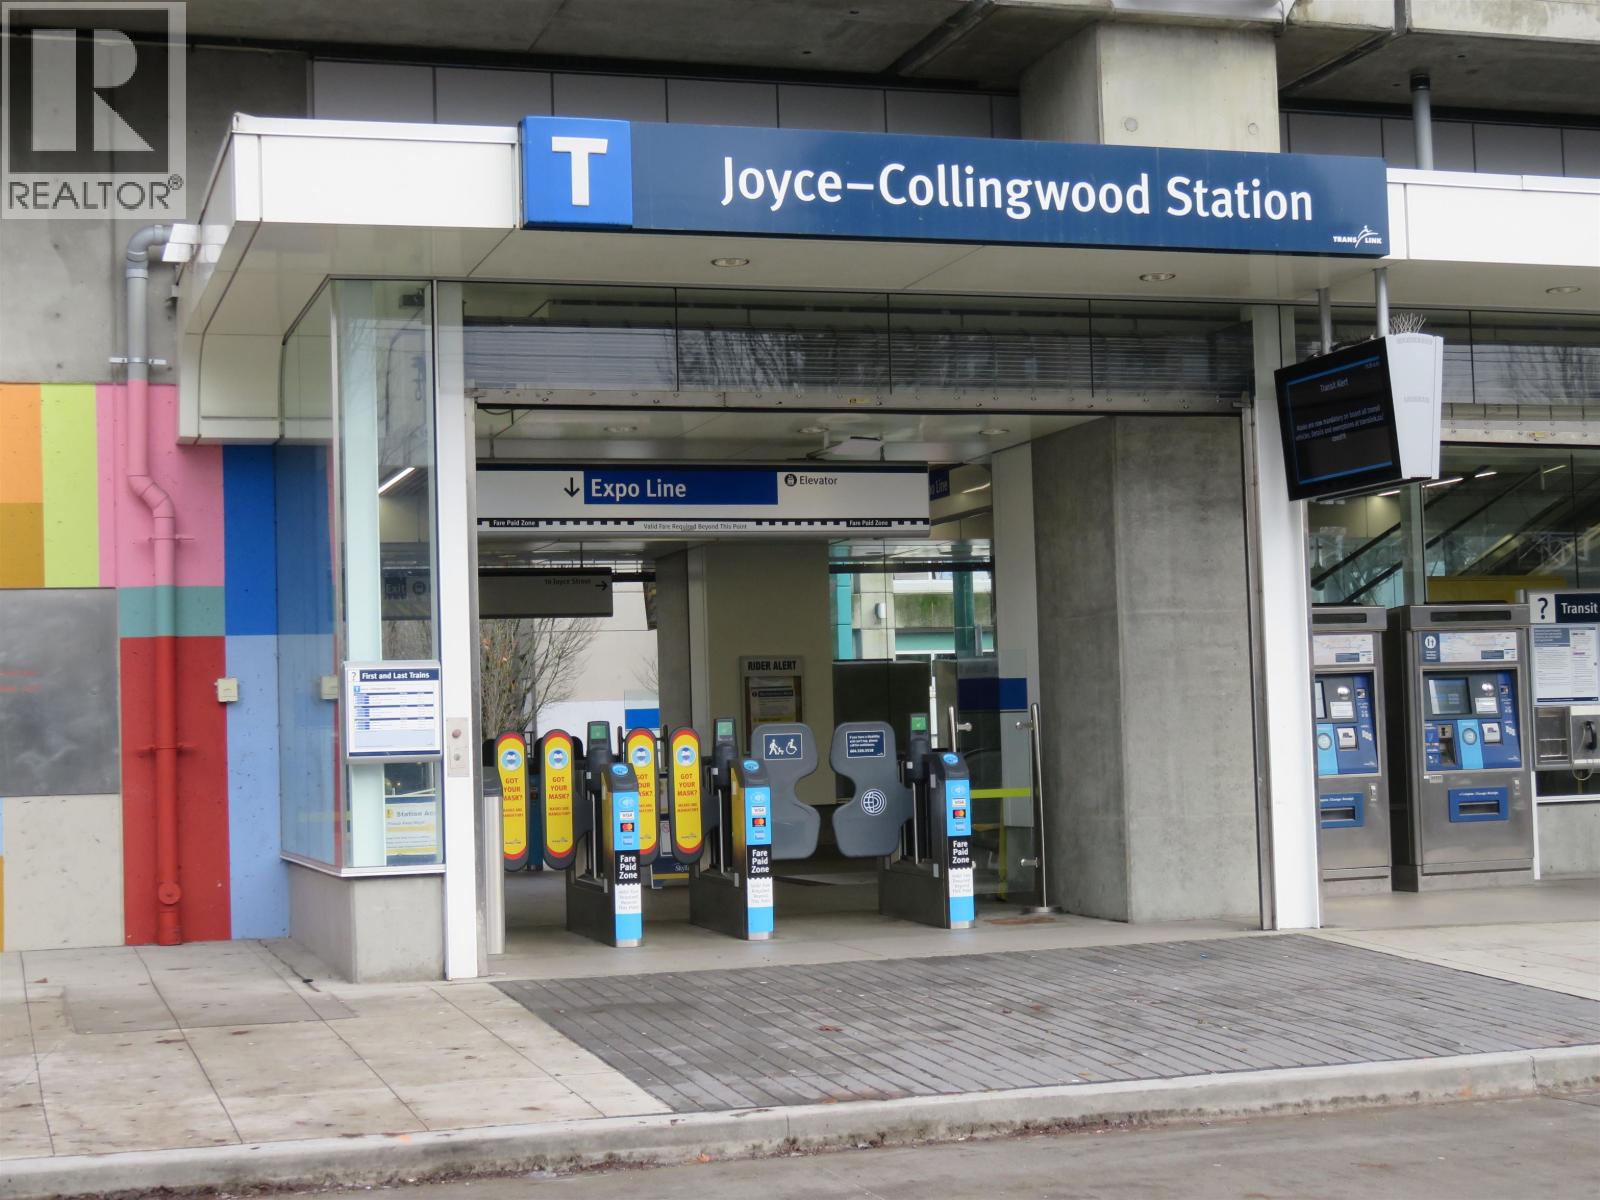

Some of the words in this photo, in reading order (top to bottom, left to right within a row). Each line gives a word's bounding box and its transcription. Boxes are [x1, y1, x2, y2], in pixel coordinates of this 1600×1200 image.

[551, 136, 608, 206] T
[1166, 175, 1313, 221] Station
[799, 475, 838, 486] Elevator
[591, 478, 639, 501] Expo
[646, 479, 686, 498] Line
[1561, 602, 1598, 614] Transit
[772, 660, 797, 671] ALERT
[362, 672, 377, 680] First
[379, 672, 391, 680] and
[409, 671, 430, 679] Trains
[953, 840, 968, 848] Fare
[752, 849, 768, 857] Fare
[953, 848, 969, 856] Paid
[620, 854, 637, 863] Fare
[752, 857, 769, 865] Paid
[952, 856, 969, 864] Zone
[620, 863, 637, 871] Paid
[751, 865, 769, 874] Zone
[619, 871, 638, 880] Zone
